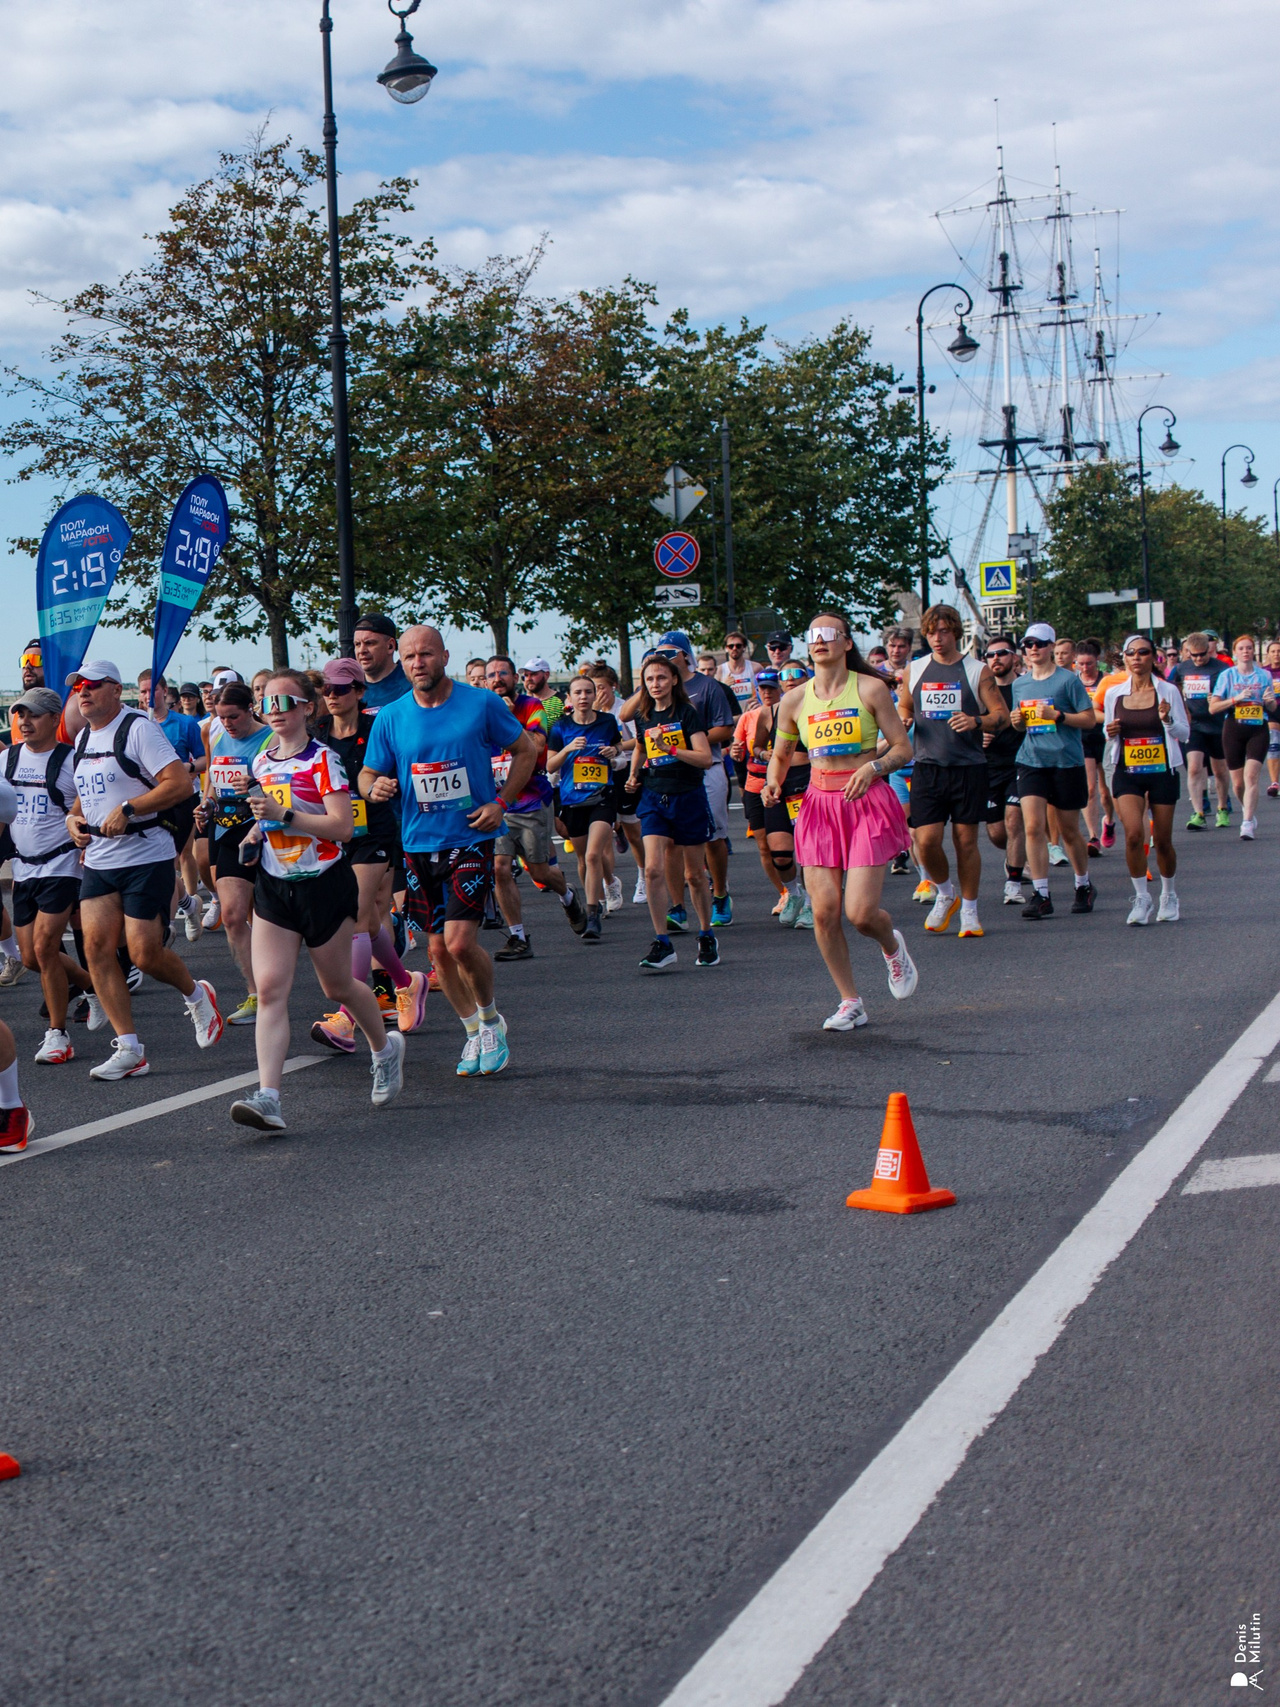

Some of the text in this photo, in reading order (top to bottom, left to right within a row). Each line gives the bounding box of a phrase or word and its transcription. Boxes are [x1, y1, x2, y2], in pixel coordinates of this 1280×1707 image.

[190, 494, 208, 508] ПОЛУ
[189, 504, 220, 523] МАРАФОН
[60, 519, 86, 533] ПОЛУ
[61, 524, 110, 542] МАРАФОН
[175, 529, 211, 574] 2:19
[51, 551, 107, 596] 2:19
[49, 610, 72, 628] 6:35
[1187, 683, 1206, 691] 7024
[926, 693, 956, 705] 4520
[1240, 707, 1260, 715] 6929
[815, 721, 853, 739] 6690
[813, 748, 819, 756] E
[1130, 748, 1160, 759] 4802
[652, 758, 657, 766] E
[581, 766, 601, 777] 393
[77, 773, 106, 797] 2:19
[420, 773, 461, 793] 1716
[17, 793, 48, 814] 2:19
[423, 803, 430, 812] E
